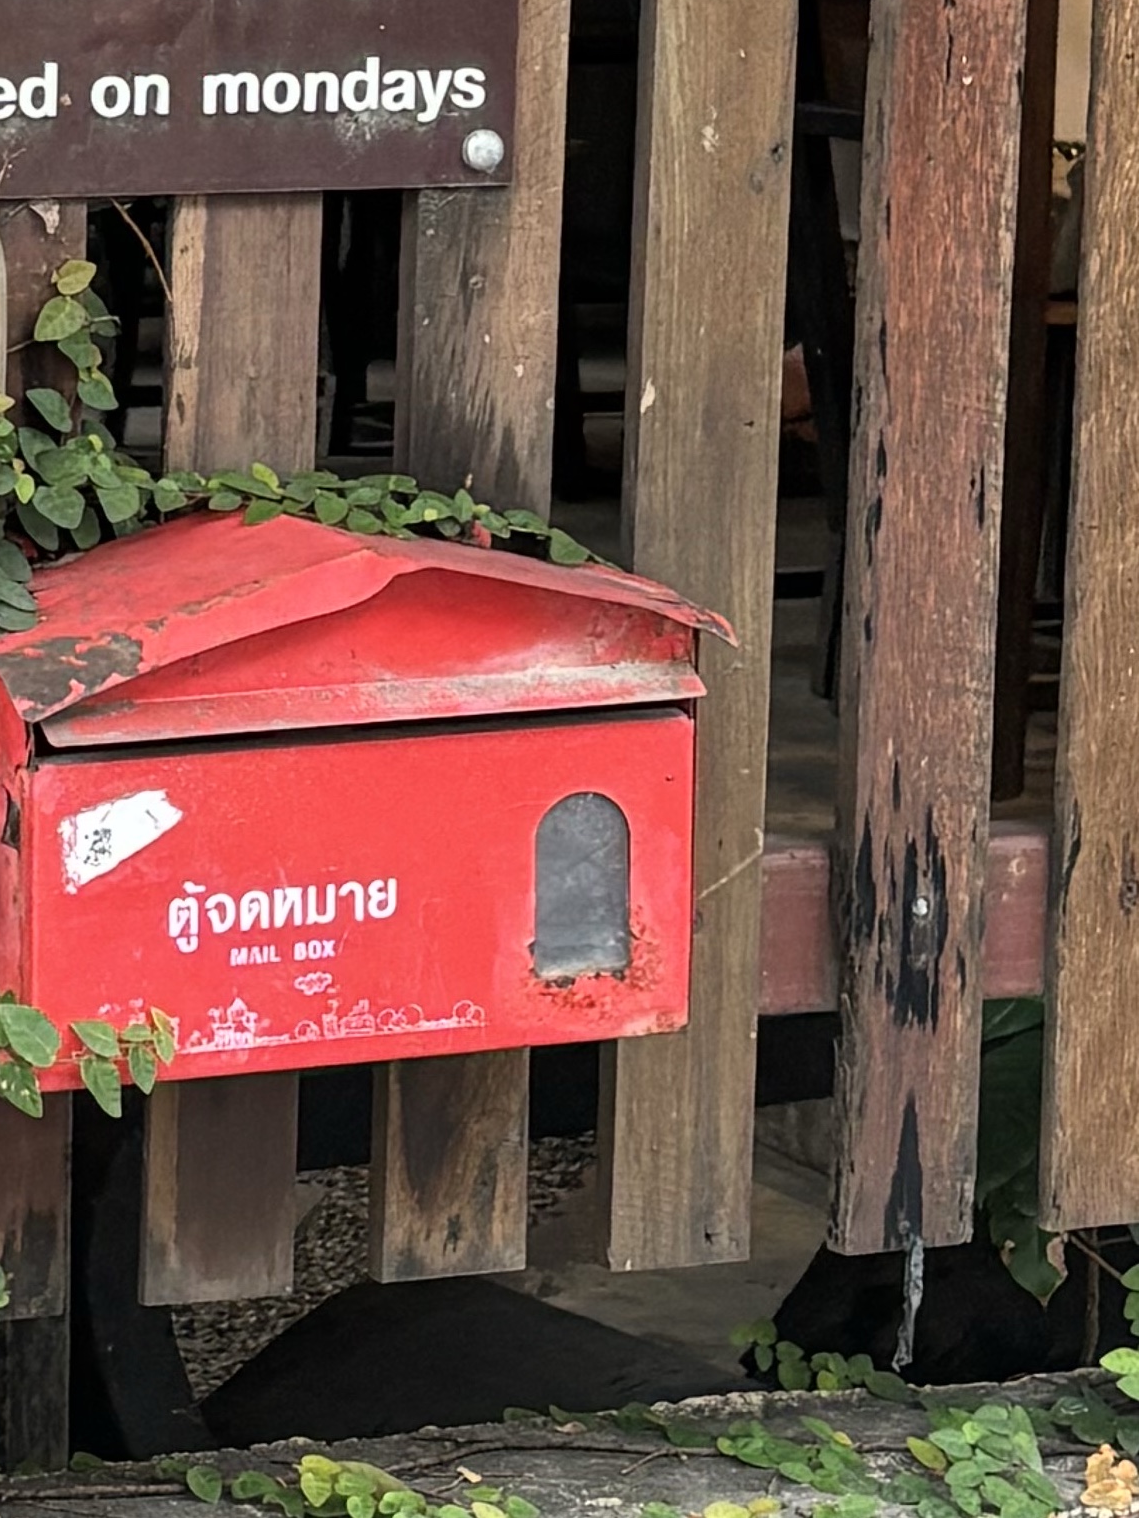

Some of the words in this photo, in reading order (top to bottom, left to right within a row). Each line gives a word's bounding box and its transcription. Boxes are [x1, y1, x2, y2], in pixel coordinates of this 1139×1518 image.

[90, 73, 169, 118] on
[202, 56, 486, 123] mondays
[168, 878, 398, 953] ตู้จดหมาย
[229, 945, 281, 966] MAIL
[293, 940, 336, 961] BOX
